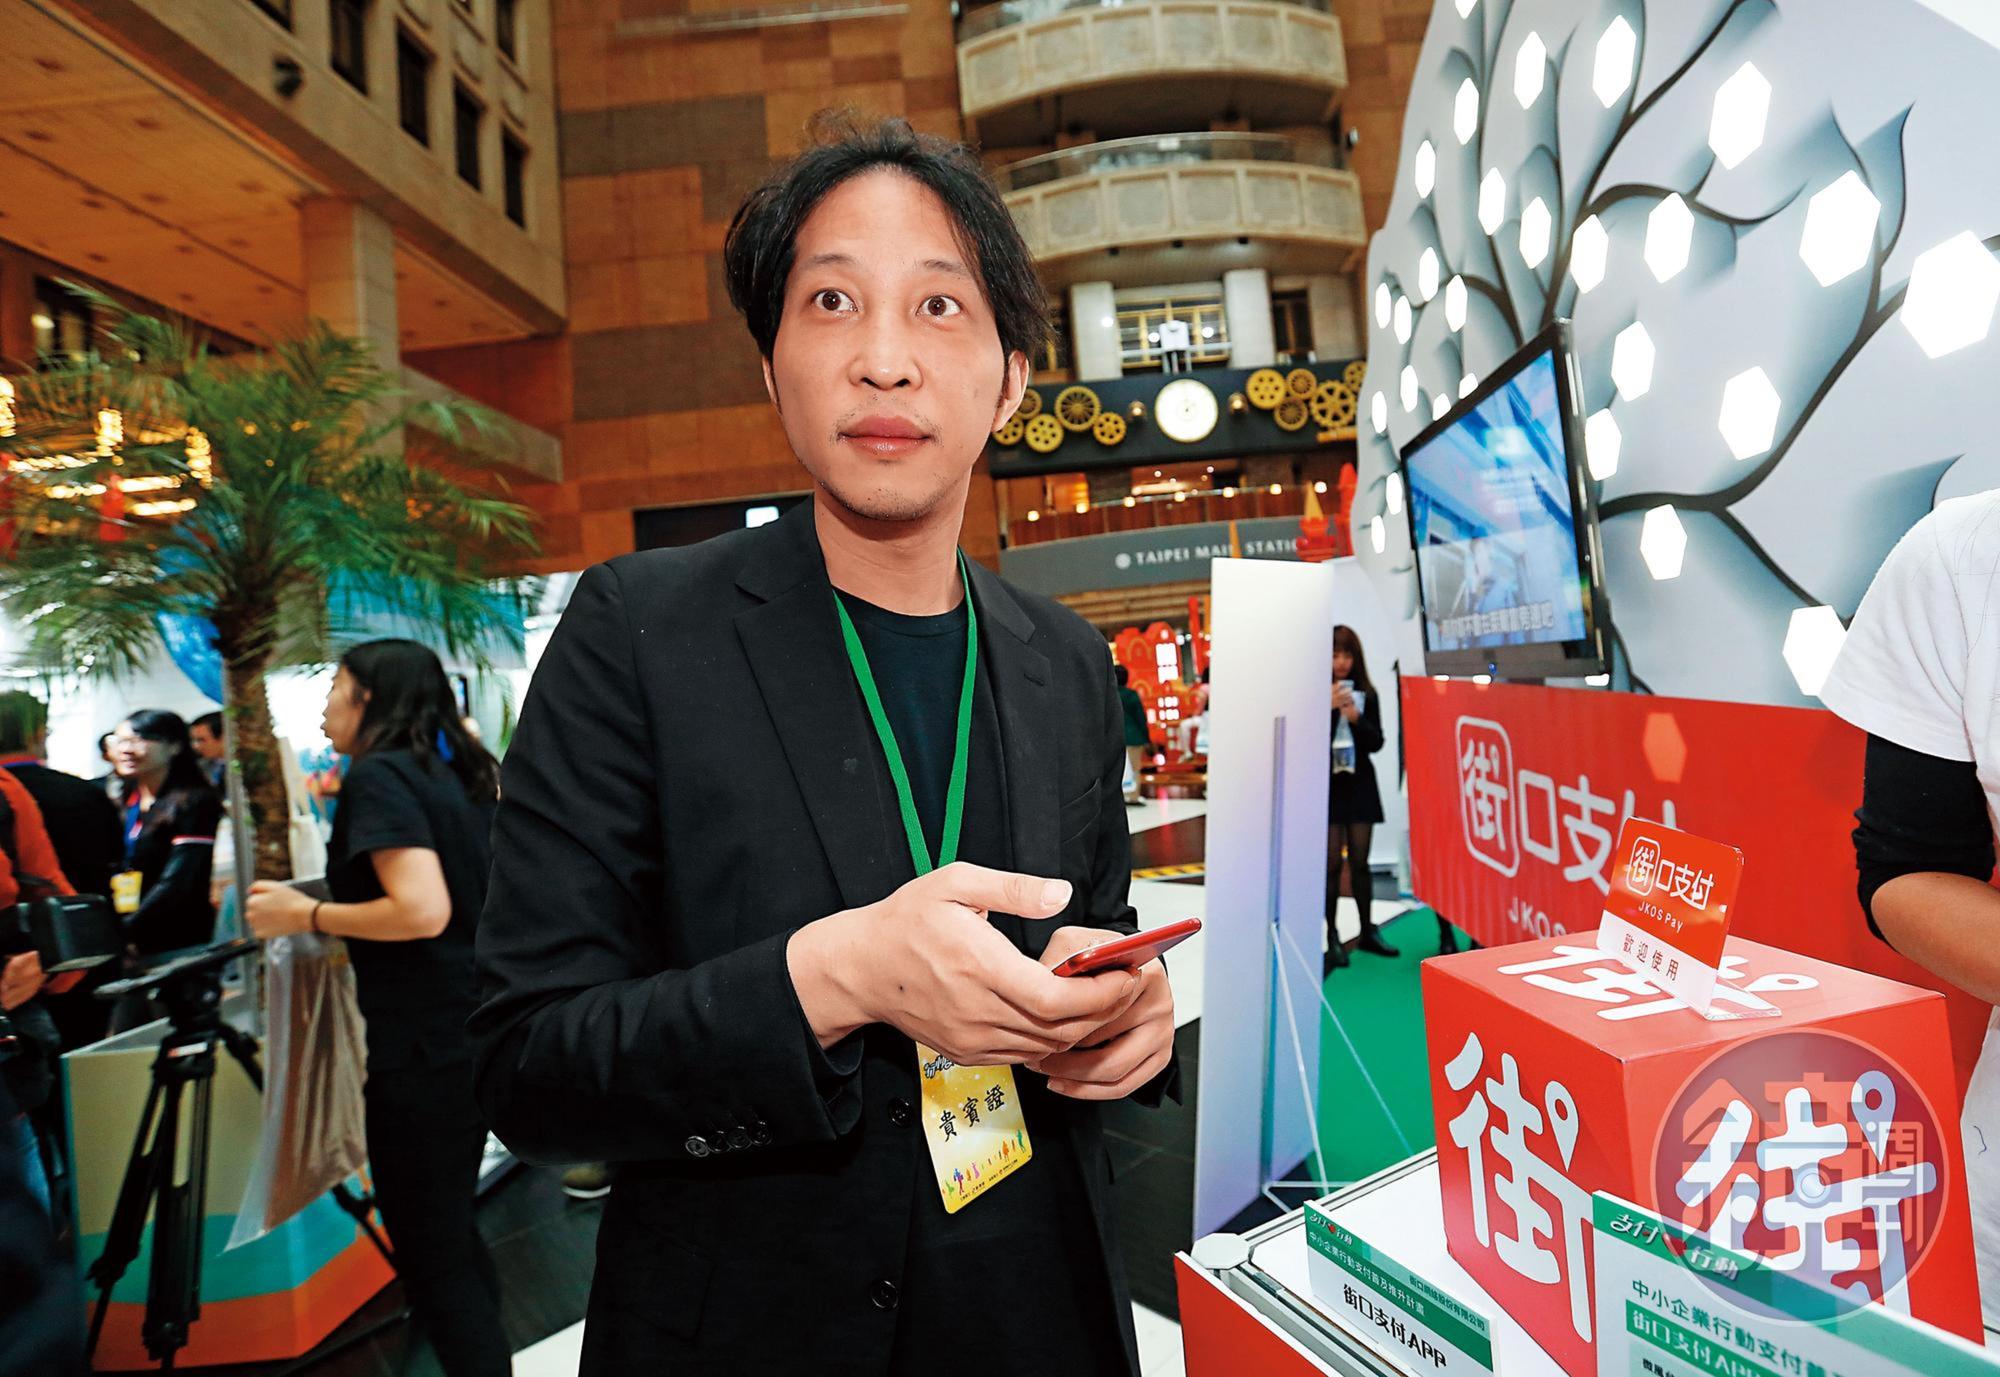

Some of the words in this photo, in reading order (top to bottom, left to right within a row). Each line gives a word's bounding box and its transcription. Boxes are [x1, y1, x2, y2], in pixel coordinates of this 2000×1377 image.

[1136, 546, 1190, 566] TAIPEI
[1246, 538, 1299, 556] STATI
[1630, 840, 1715, 911] 街口支付
[1638, 901, 1664, 922] JKOS
[1664, 912, 1684, 934] Pay
[1622, 932, 1680, 982] 歡迎使用
[938, 1083, 1005, 1143] 貴賓證
[1444, 1032, 1594, 1344] 街
[1609, 1213, 1660, 1245] 支付
[1689, 1246, 1739, 1281] 行動
[1343, 1283, 1448, 1369] 街口支付APP
